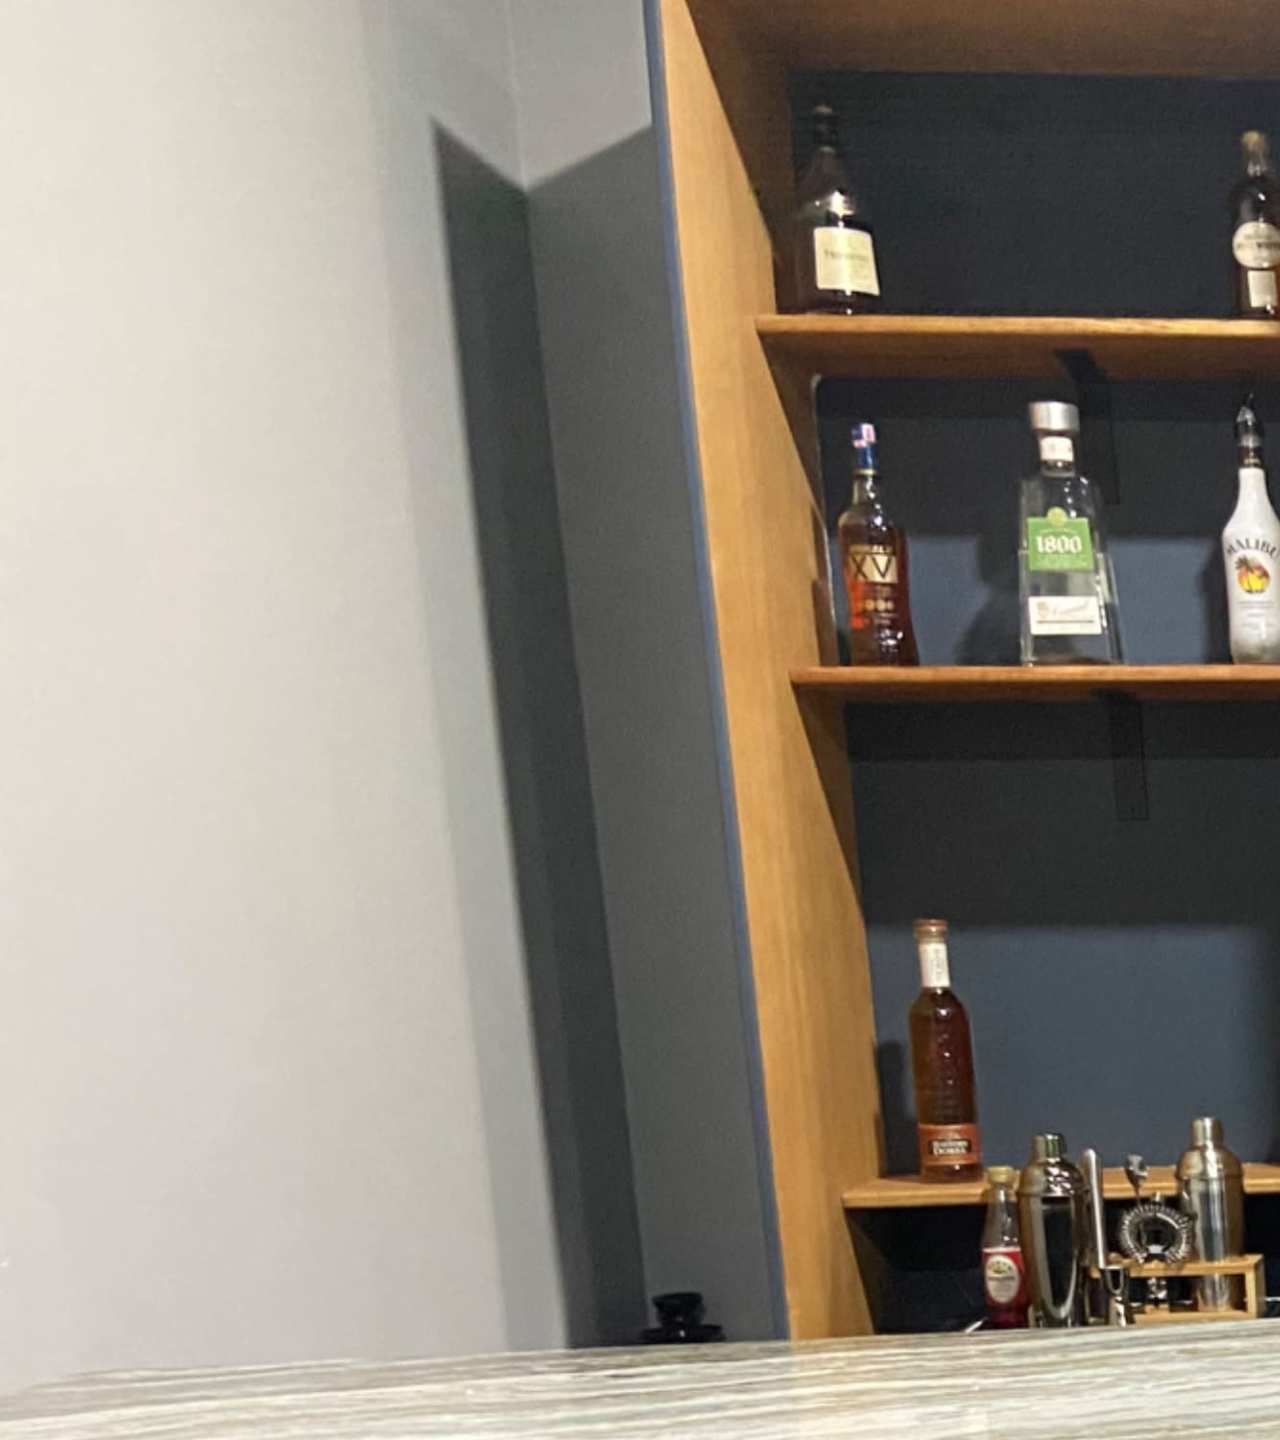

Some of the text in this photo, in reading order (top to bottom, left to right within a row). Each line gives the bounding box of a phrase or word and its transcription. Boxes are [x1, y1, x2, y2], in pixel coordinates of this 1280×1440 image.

[1036, 536, 1082, 553] 1800
[1226, 538, 1280, 560] MALIBU
[851, 555, 893, 580] XV
